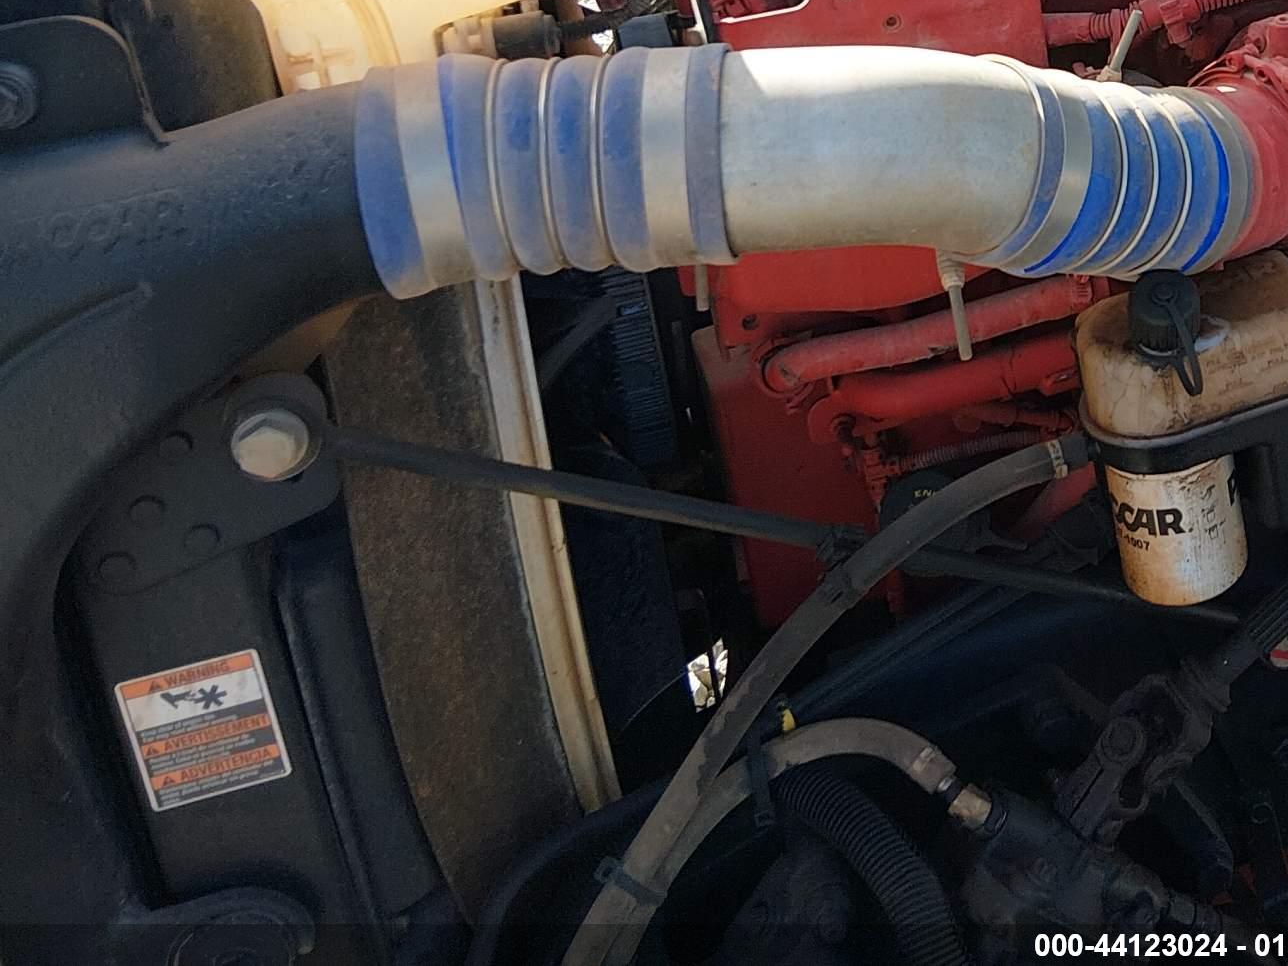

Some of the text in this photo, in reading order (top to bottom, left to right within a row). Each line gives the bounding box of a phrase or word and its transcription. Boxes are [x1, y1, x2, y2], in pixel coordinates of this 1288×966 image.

[165, 661, 230, 687] WARNING
[164, 715, 271, 752] AVERTISSEMENT
[180, 747, 271, 780] ADVERTENCIA
